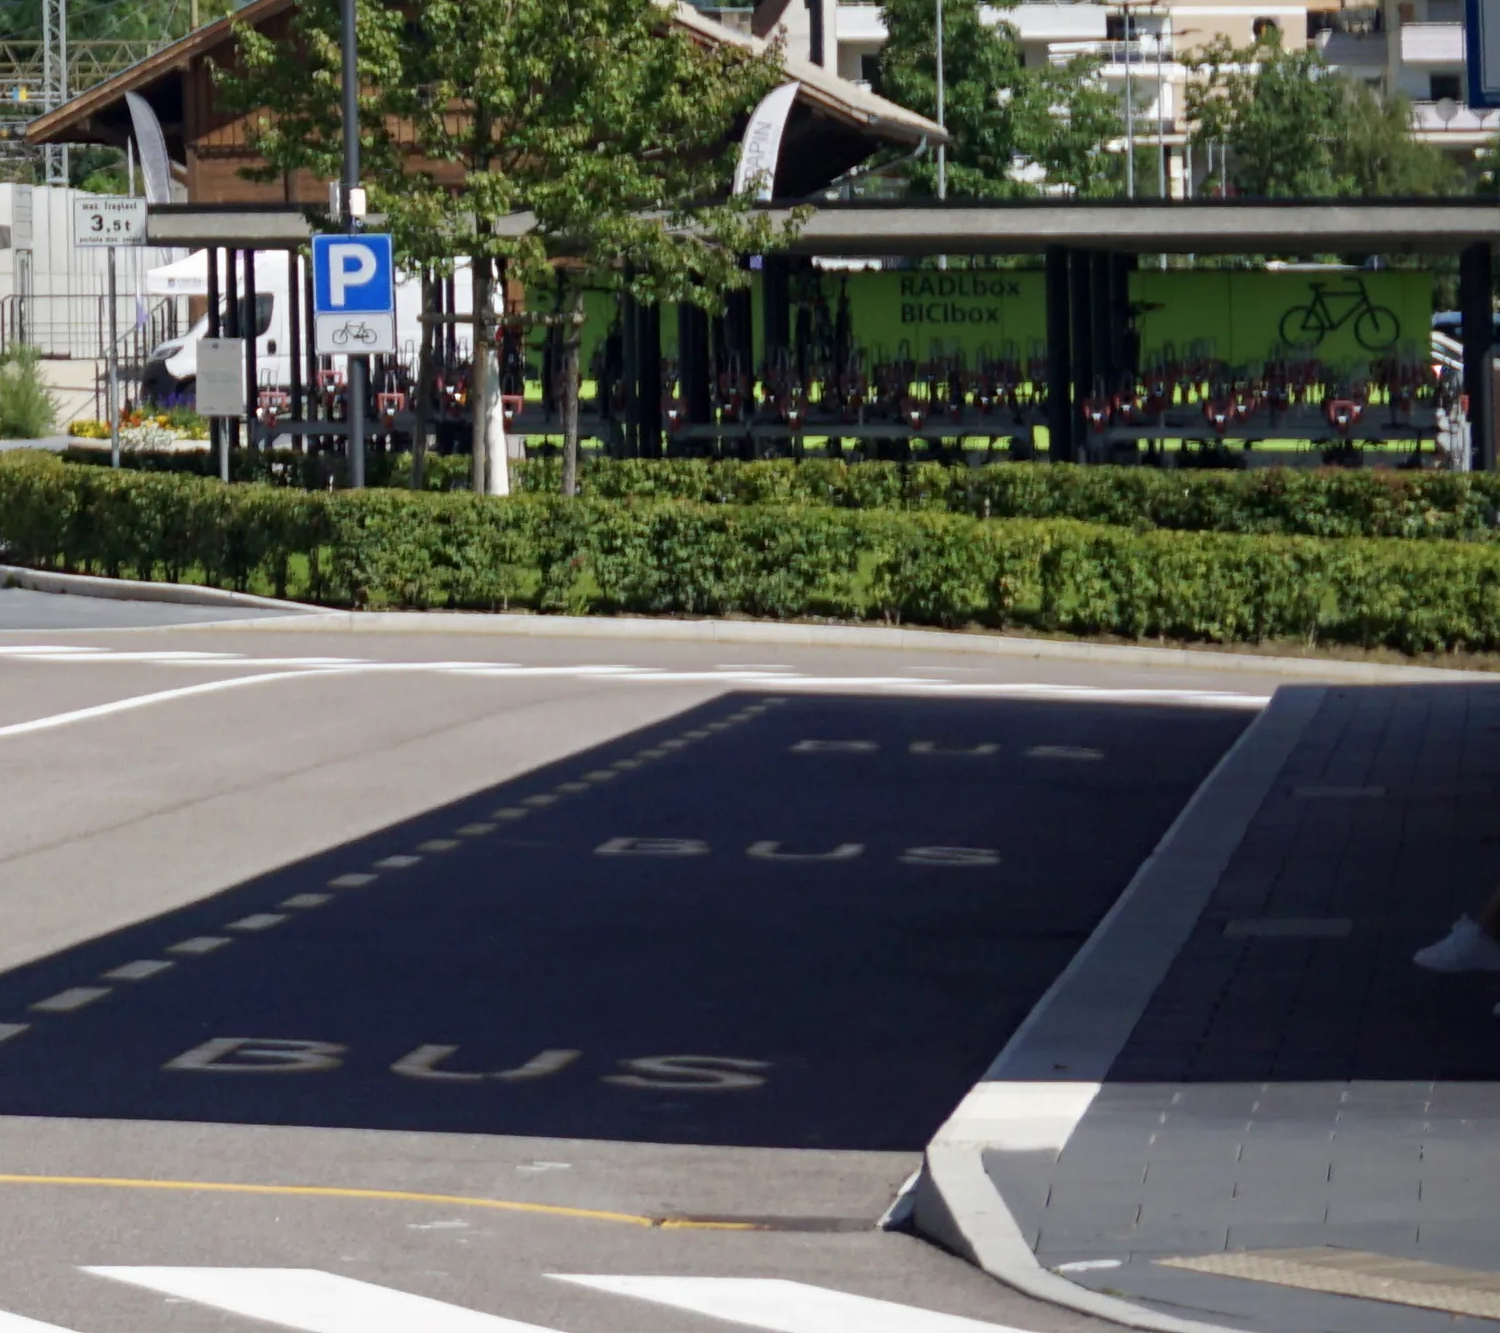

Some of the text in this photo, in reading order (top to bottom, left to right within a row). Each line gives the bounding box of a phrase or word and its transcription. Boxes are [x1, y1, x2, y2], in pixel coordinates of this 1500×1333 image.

[91, 214, 132, 233] 3,5 t
[329, 243, 377, 306] P
[901, 273, 1020, 298] RADLbox
[901, 301, 1000, 323] BICIbox
[593, 837, 1000, 865] BUS
[162, 1037, 775, 1090] BUS
